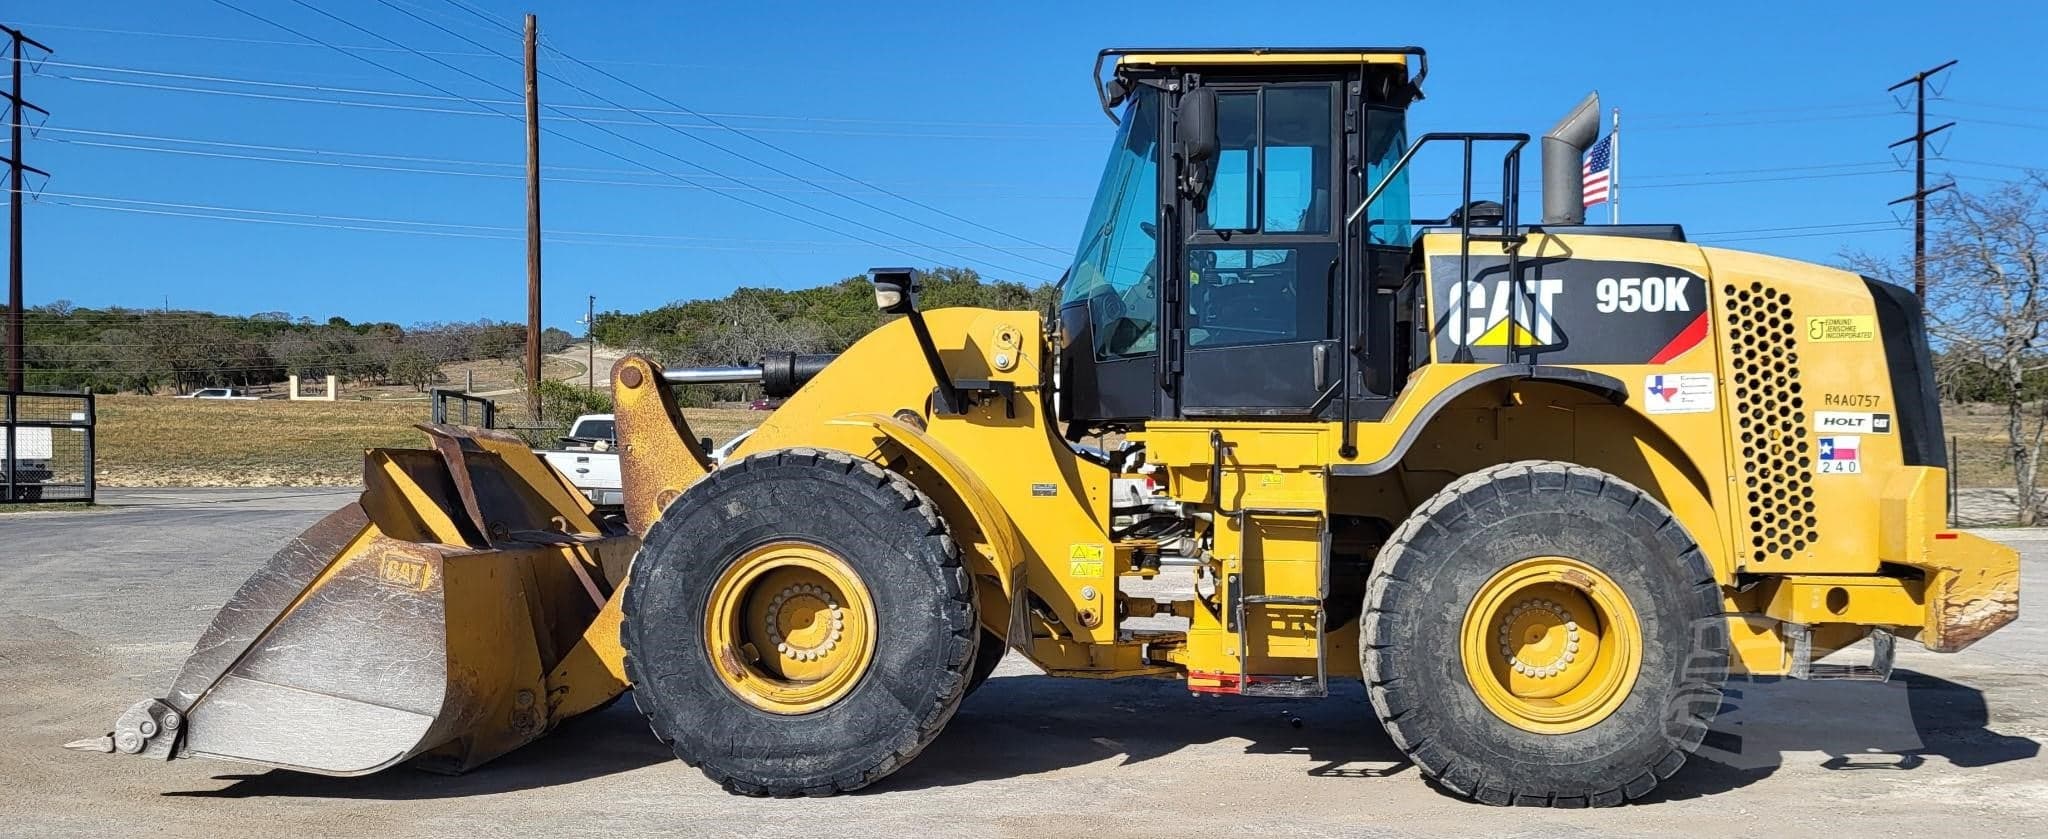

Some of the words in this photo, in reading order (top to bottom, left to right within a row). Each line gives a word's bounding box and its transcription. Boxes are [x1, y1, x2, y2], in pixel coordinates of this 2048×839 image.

[1595, 277, 1691, 313] 950K
[1448, 279, 1563, 346] CAT
[1825, 393, 1881, 408] R4A0757
[1824, 417, 1866, 426] HOLT
